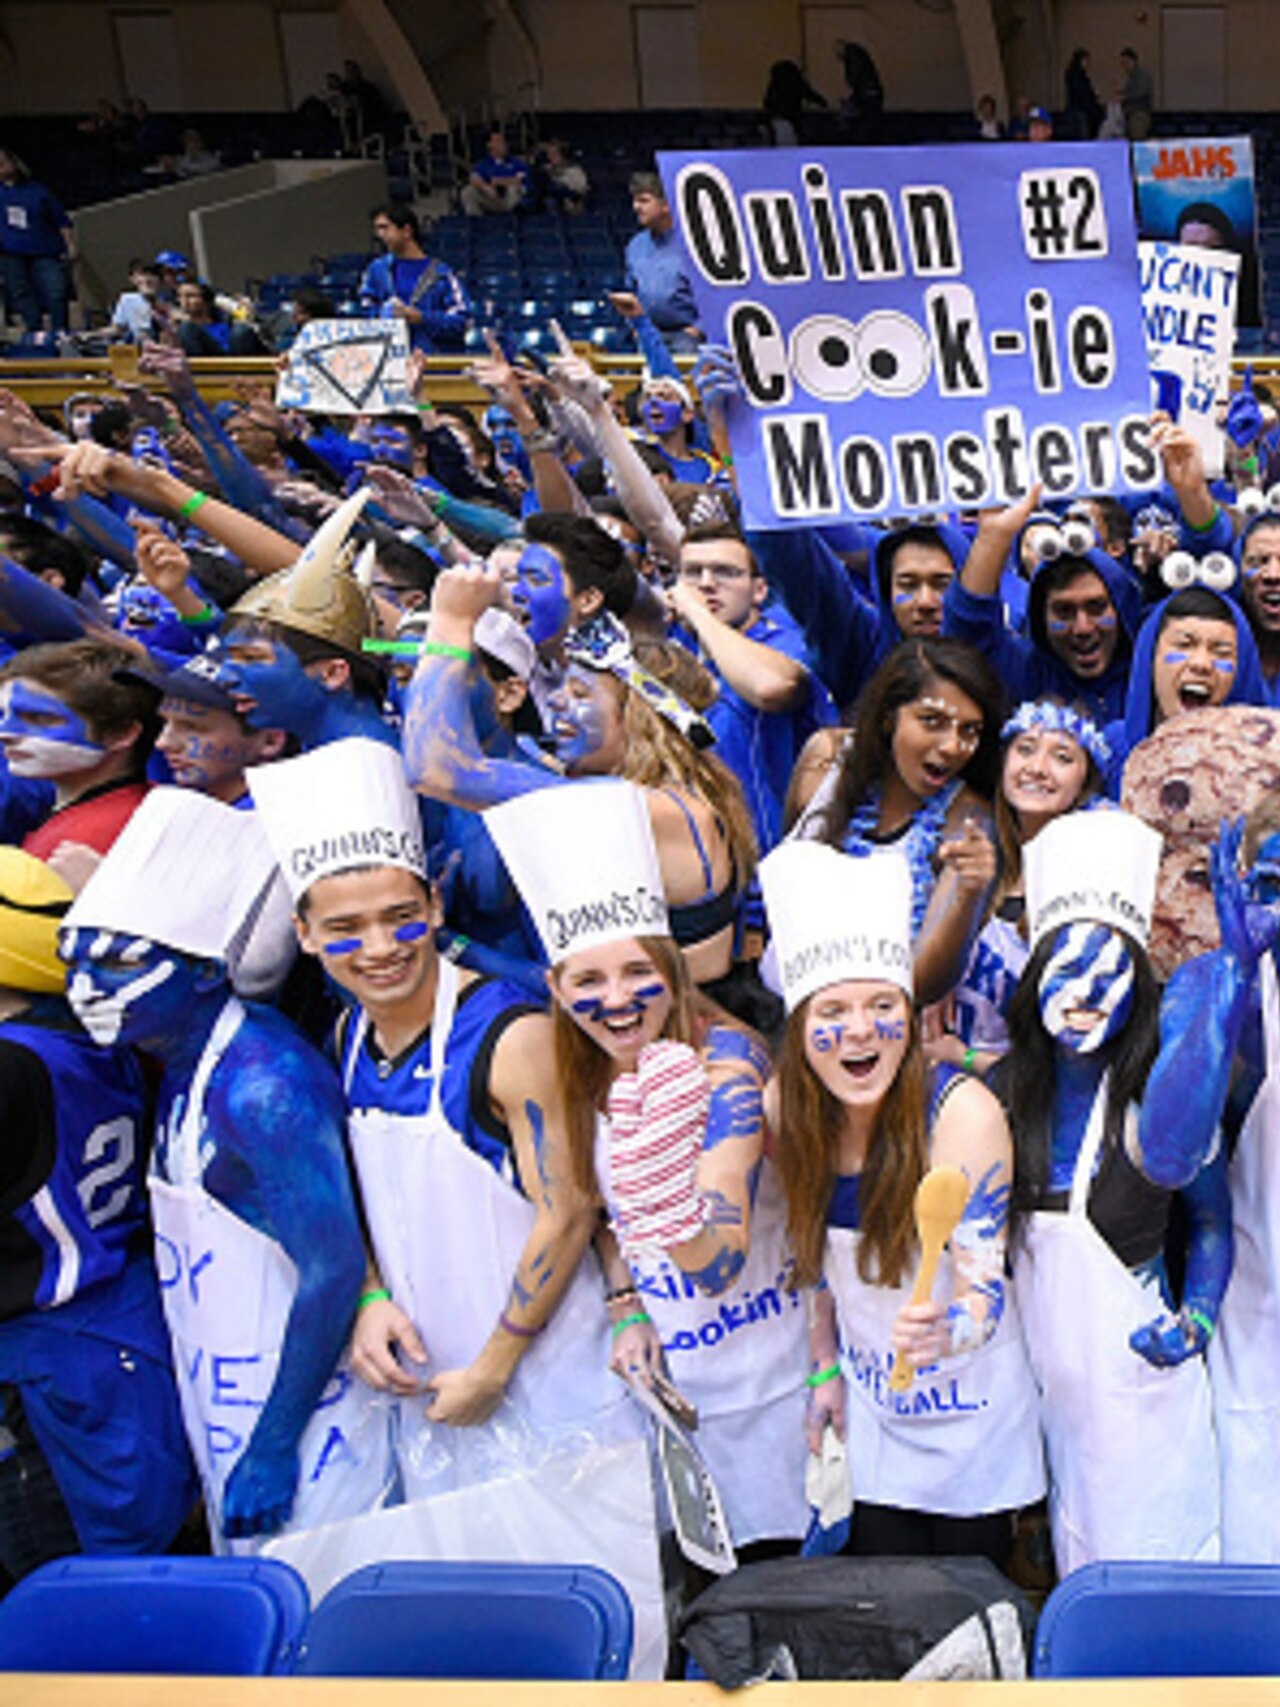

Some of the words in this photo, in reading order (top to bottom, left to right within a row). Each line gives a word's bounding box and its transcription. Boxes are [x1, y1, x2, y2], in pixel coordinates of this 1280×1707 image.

[681, 166, 957, 282] Quinn
[1025, 176, 1104, 255] #2
[767, 412, 1158, 512] Monsters
[75, 1113, 136, 1230] 2
